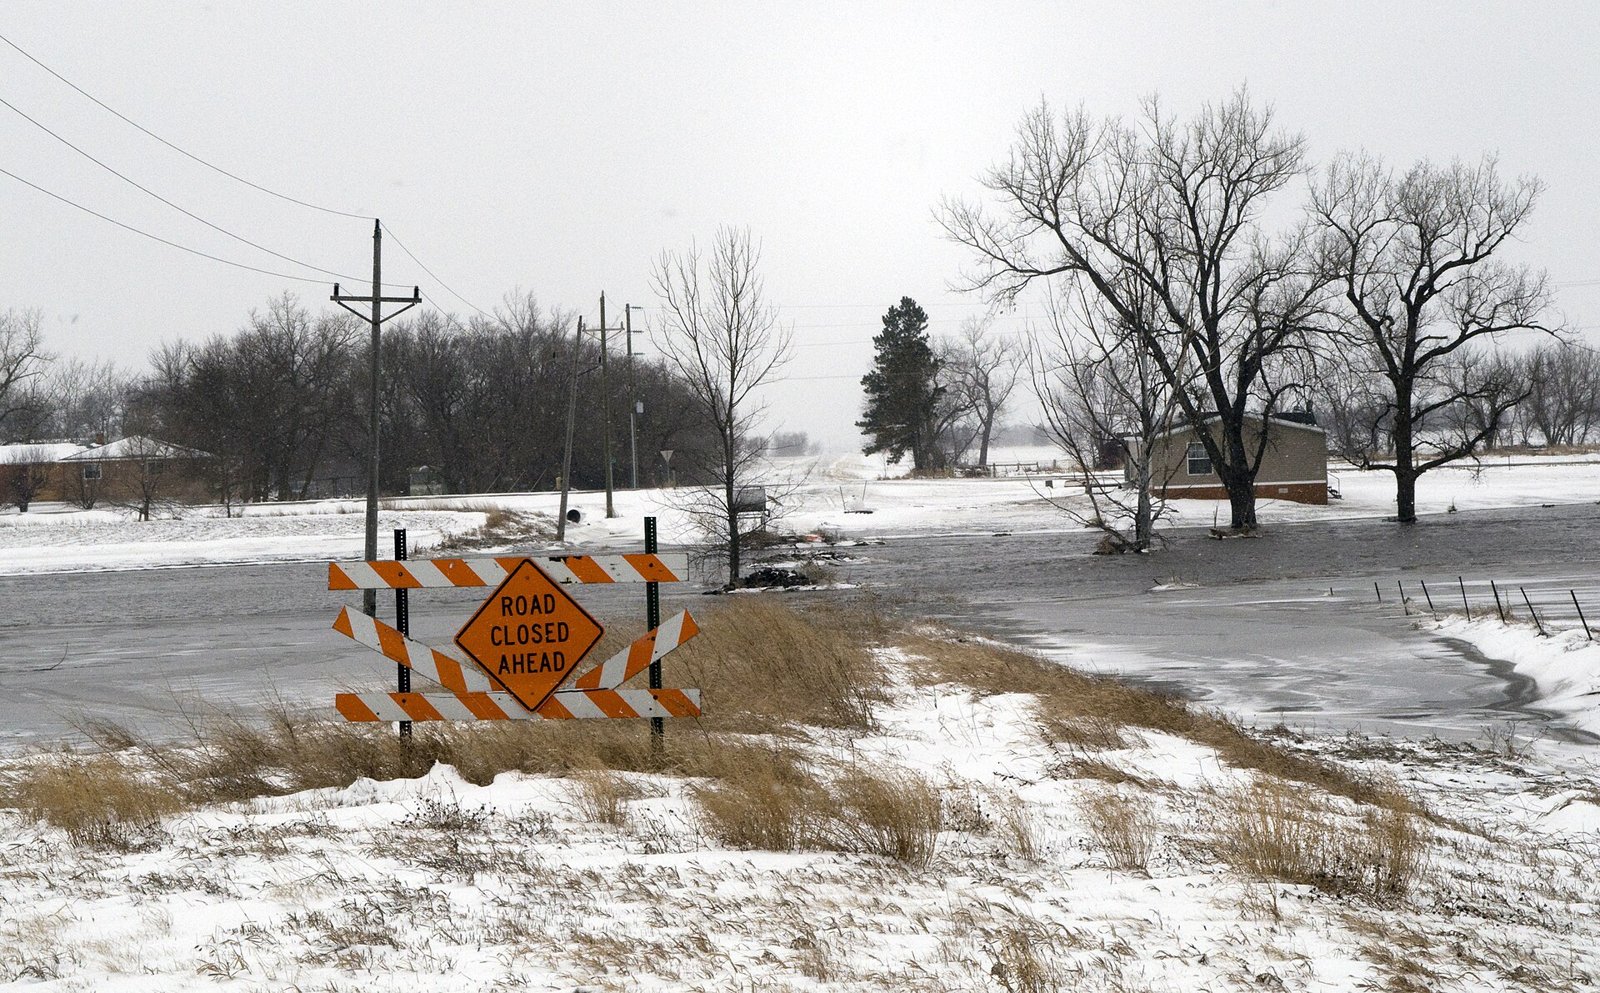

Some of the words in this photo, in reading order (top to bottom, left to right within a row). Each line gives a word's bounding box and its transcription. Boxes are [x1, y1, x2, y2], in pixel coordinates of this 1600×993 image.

[501, 593, 556, 616] ROAD
[491, 622, 569, 646] CLOSED
[498, 651, 565, 675] AHEAD
